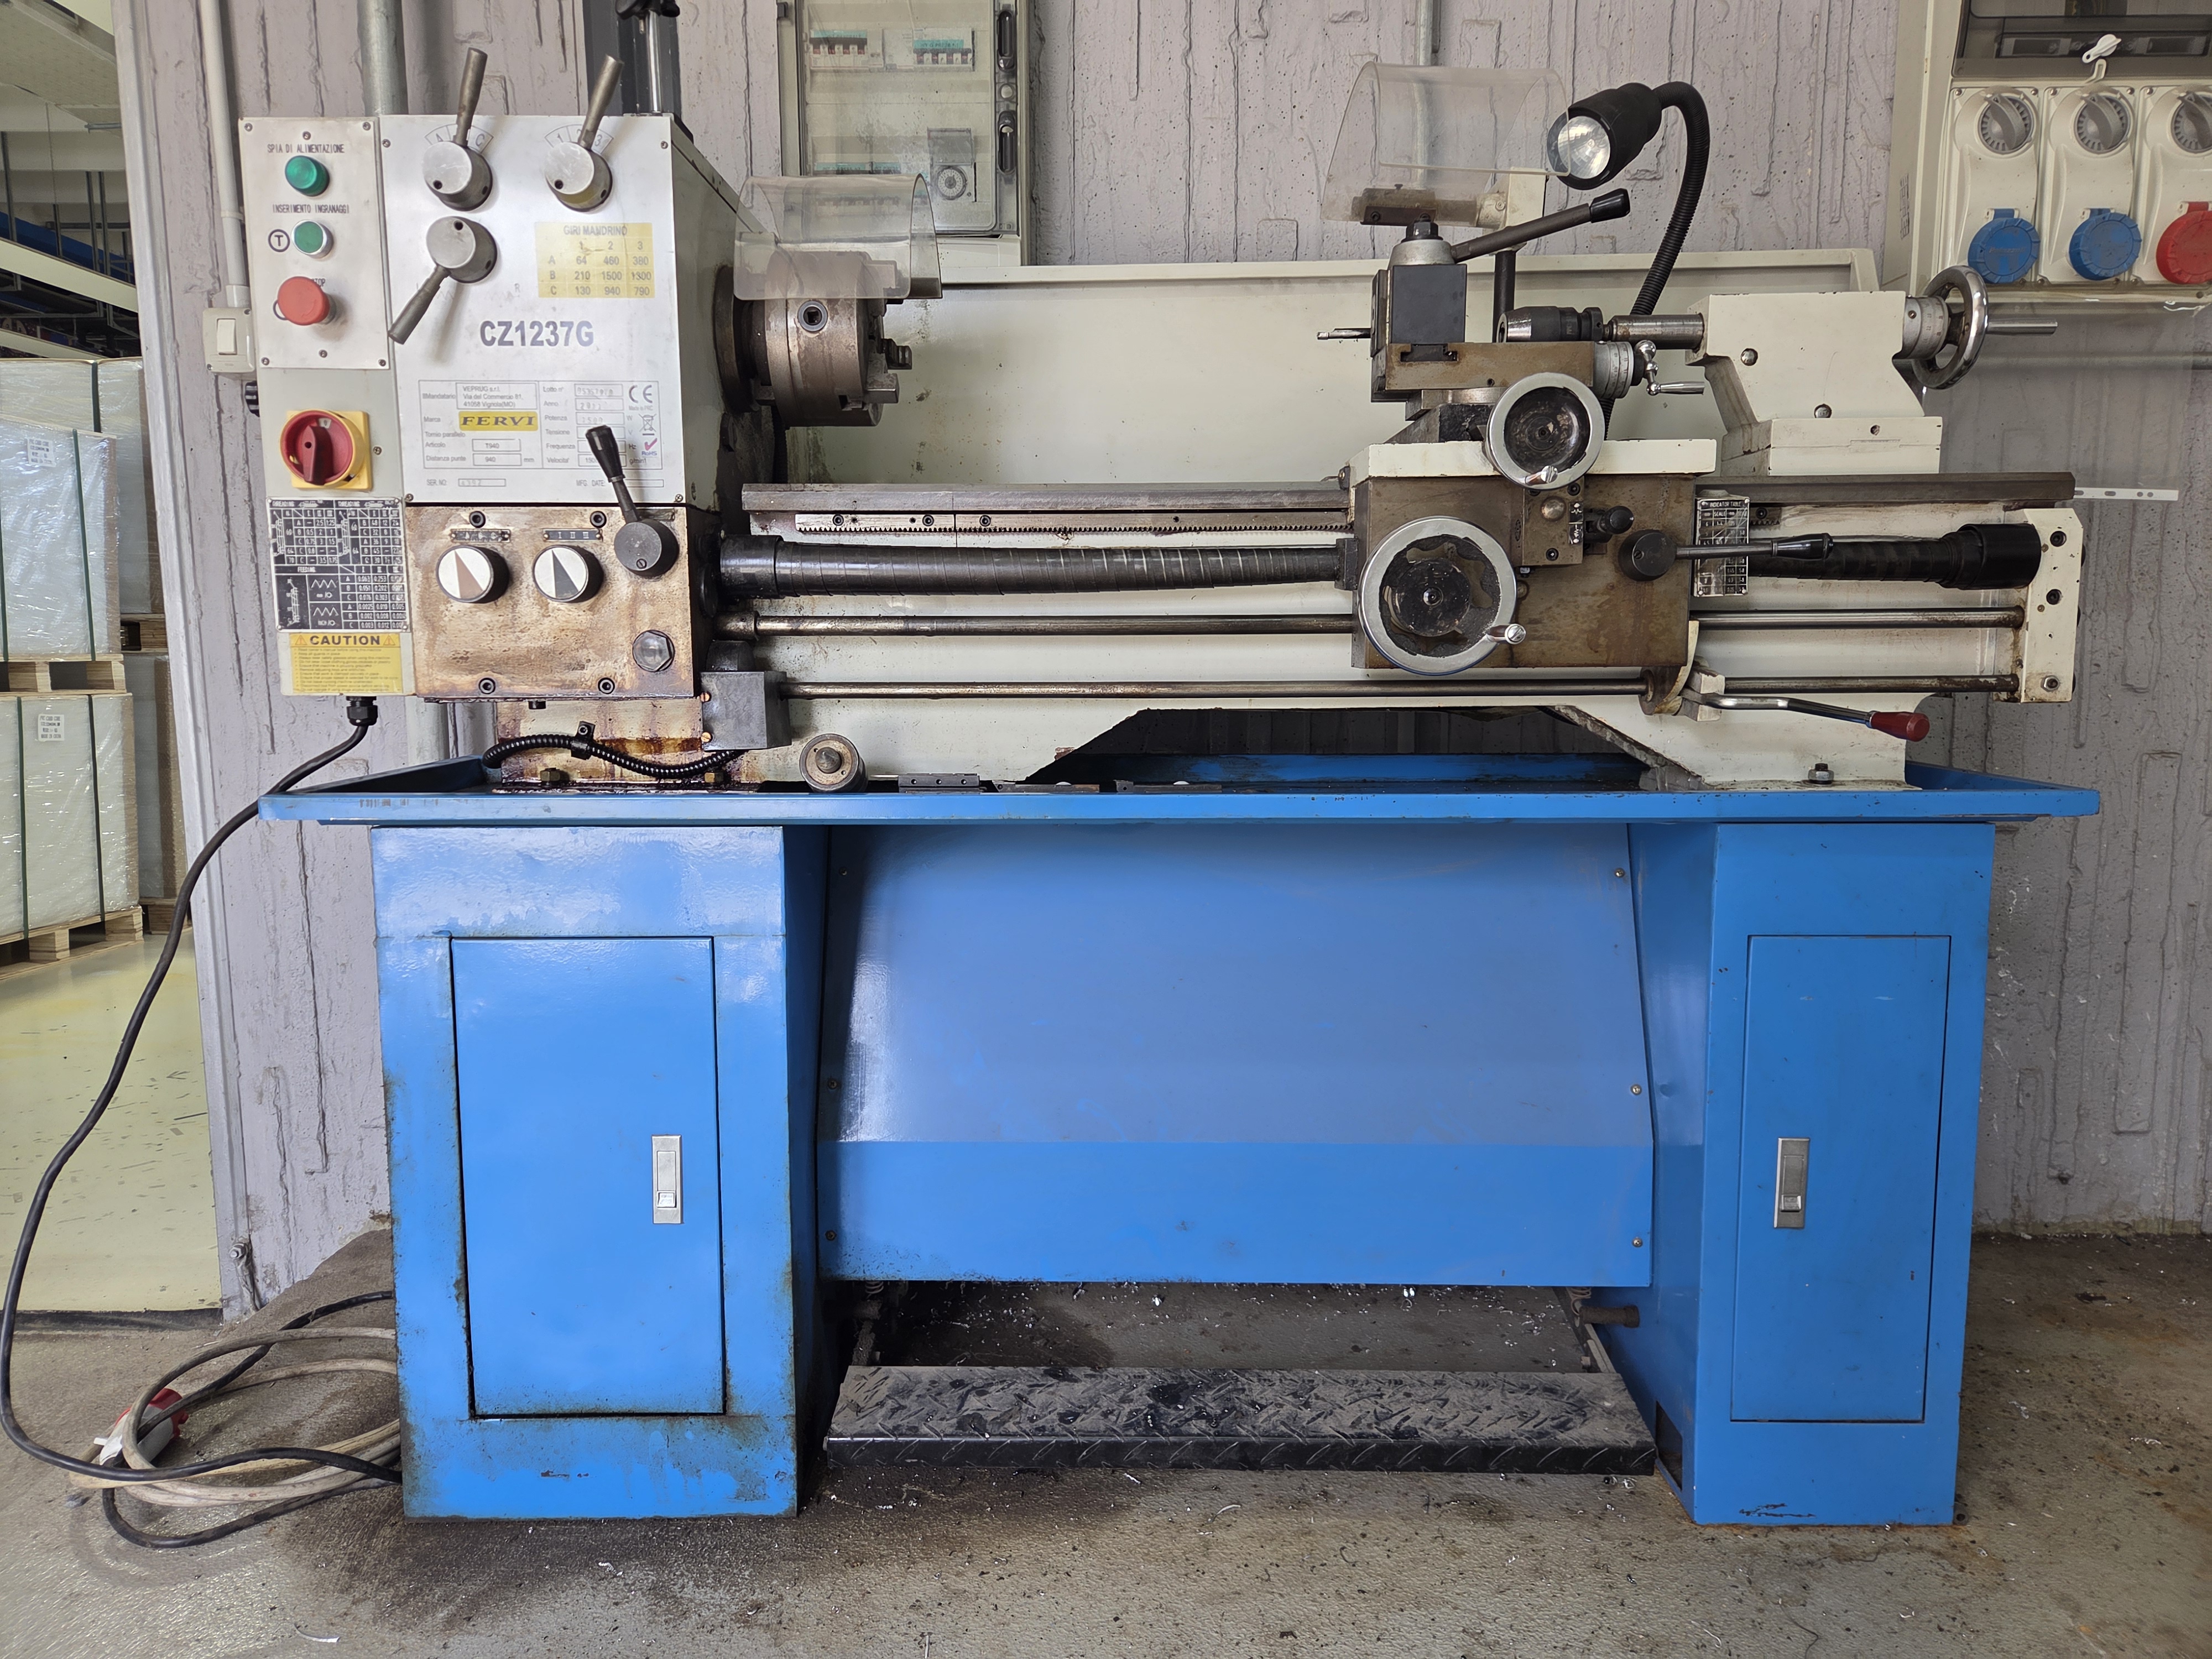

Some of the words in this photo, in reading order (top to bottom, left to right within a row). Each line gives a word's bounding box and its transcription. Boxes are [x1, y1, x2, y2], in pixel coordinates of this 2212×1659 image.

[475, 133, 485, 147] C
[594, 134, 602, 147] 3
[267, 144, 283, 153] SPIA
[285, 144, 293, 153] DI
[297, 144, 345, 153] ALIMENTAZIONE
[273, 204, 311, 213] INSERIMENTO
[315, 204, 349, 214] INGRANAGGI
[564, 226, 580, 235] GIRI
[583, 226, 628, 236] MANDRINO
[608, 241, 613, 250] 2
[638, 241, 643, 250] 3
[548, 255, 556, 264] A
[576, 255, 587, 265] 64
[633, 256, 649, 265] 380
[550, 270, 556, 279] B
[575, 271, 591, 280] 210
[602, 271, 622, 280] 1500
[550, 285, 557, 295] C
[575, 286, 591, 295] 130
[604, 286, 620, 295] 940
[634, 286, 650, 296] 790
[480, 320, 594, 347] CZ1237G
[629, 384, 653, 404] CE
[461, 416, 536, 426] FERVI
[310, 635, 380, 645] CAUTION
